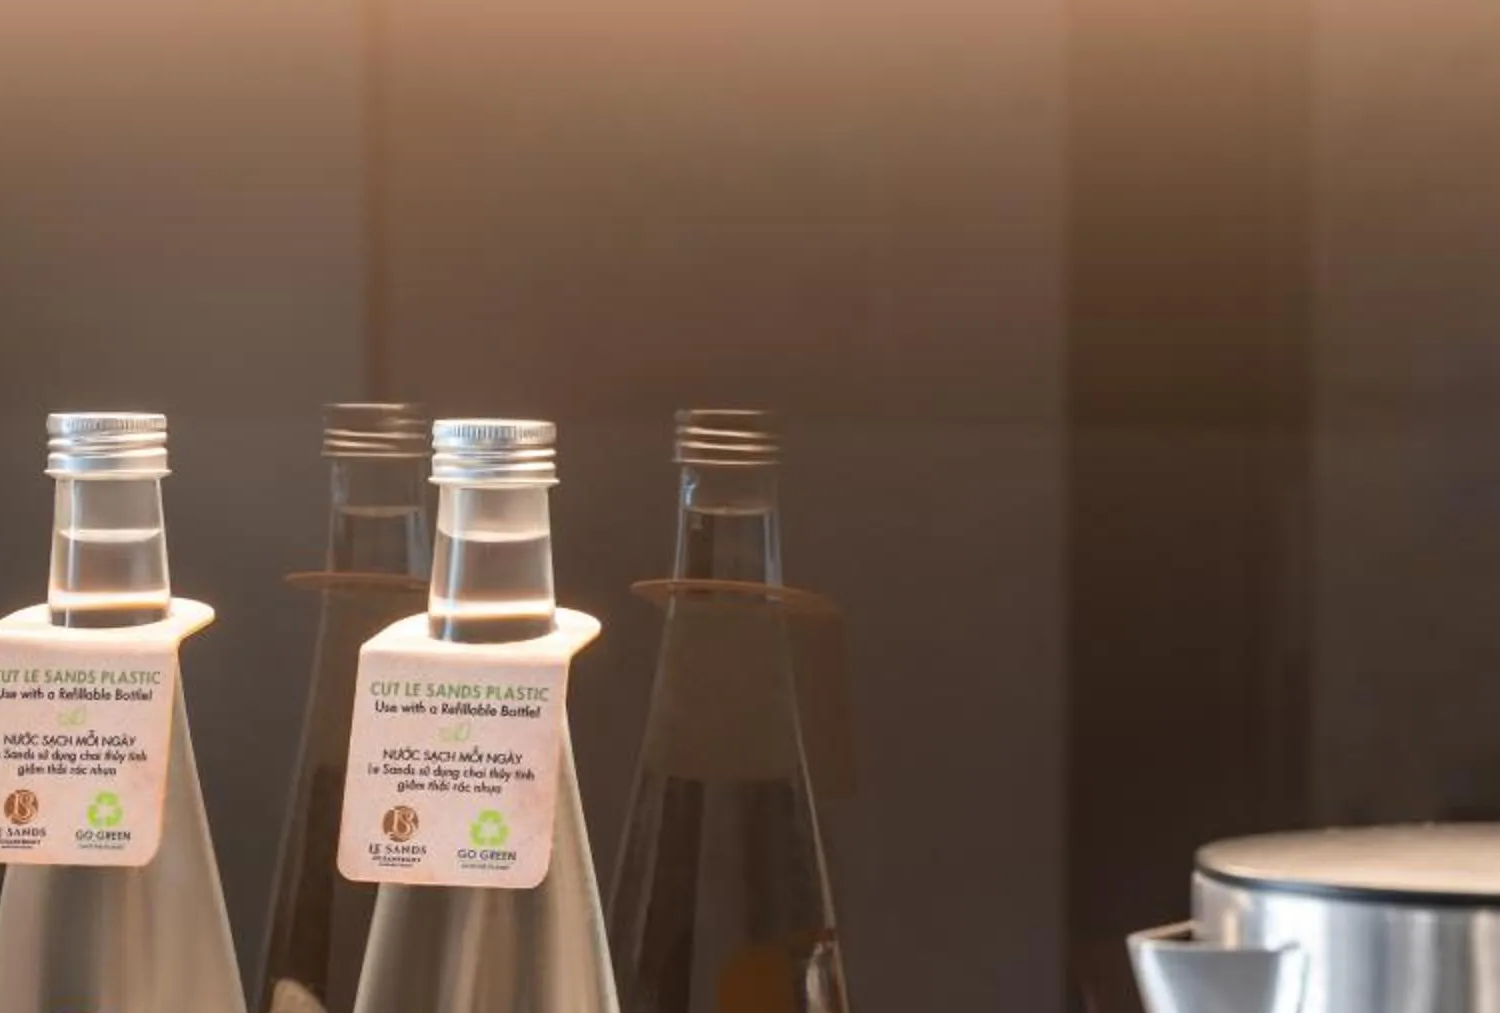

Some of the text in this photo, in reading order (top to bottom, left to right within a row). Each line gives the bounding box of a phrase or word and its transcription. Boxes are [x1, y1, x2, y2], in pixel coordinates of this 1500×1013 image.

[24, 670, 38, 684] LE
[43, 670, 96, 684] SANDS
[101, 670, 161, 685] PLASTIC
[20, 688, 44, 700] with
[59, 688, 112, 701] Refillable
[369, 681, 550, 701] CUT LE SANDS PLASTIC
[375, 701, 398, 713] Use
[401, 701, 426, 714] with
[441, 703, 497, 717] Refillable
[7, 828, 47, 838] SANDS
[75, 830, 131, 841] GO GREEN
[385, 844, 427, 855] SANDS
[457, 849, 517, 861] GO GREEN
